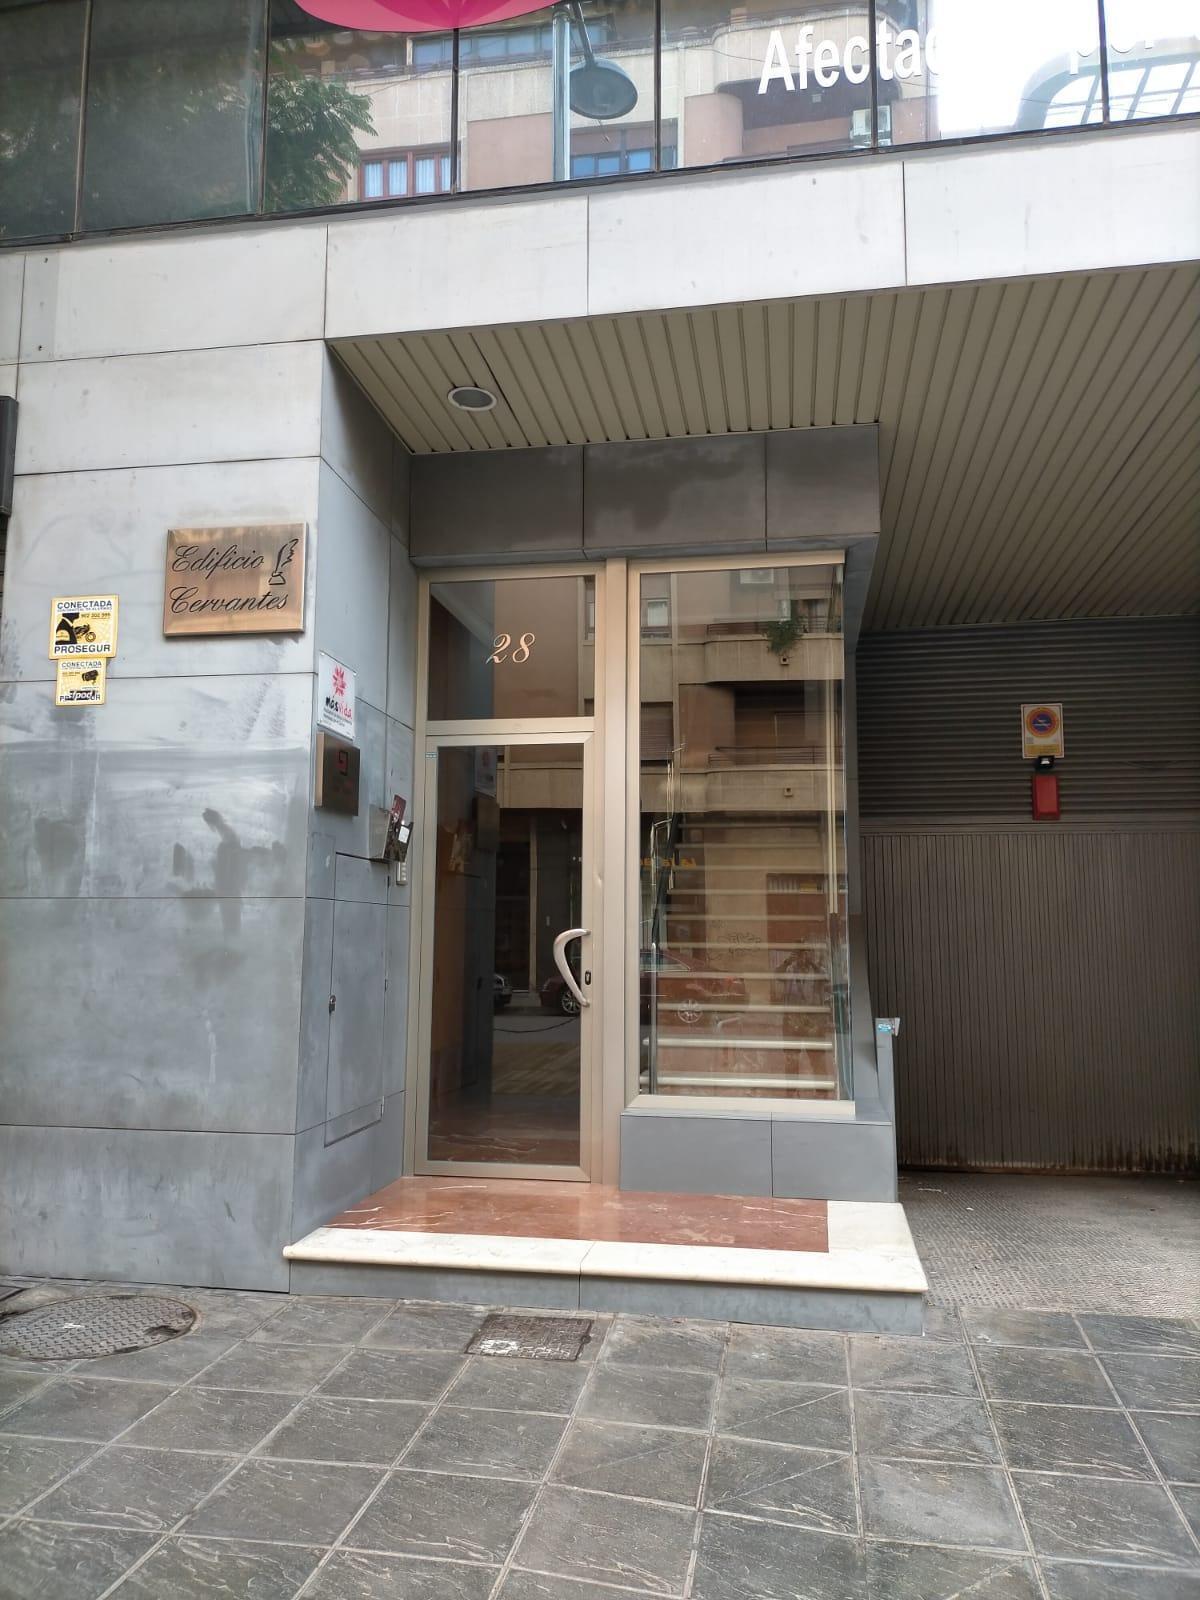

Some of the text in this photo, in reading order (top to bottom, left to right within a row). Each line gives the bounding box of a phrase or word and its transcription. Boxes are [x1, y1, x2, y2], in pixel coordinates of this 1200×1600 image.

[171, 544, 265, 580] Edificio
[57, 600, 112, 609] CONECTADA
[169, 586, 289, 613] Cervantes
[54, 644, 111, 654] PROSEGUR
[485, 632, 535, 664] 28
[61, 660, 102, 668] CONECTADA
